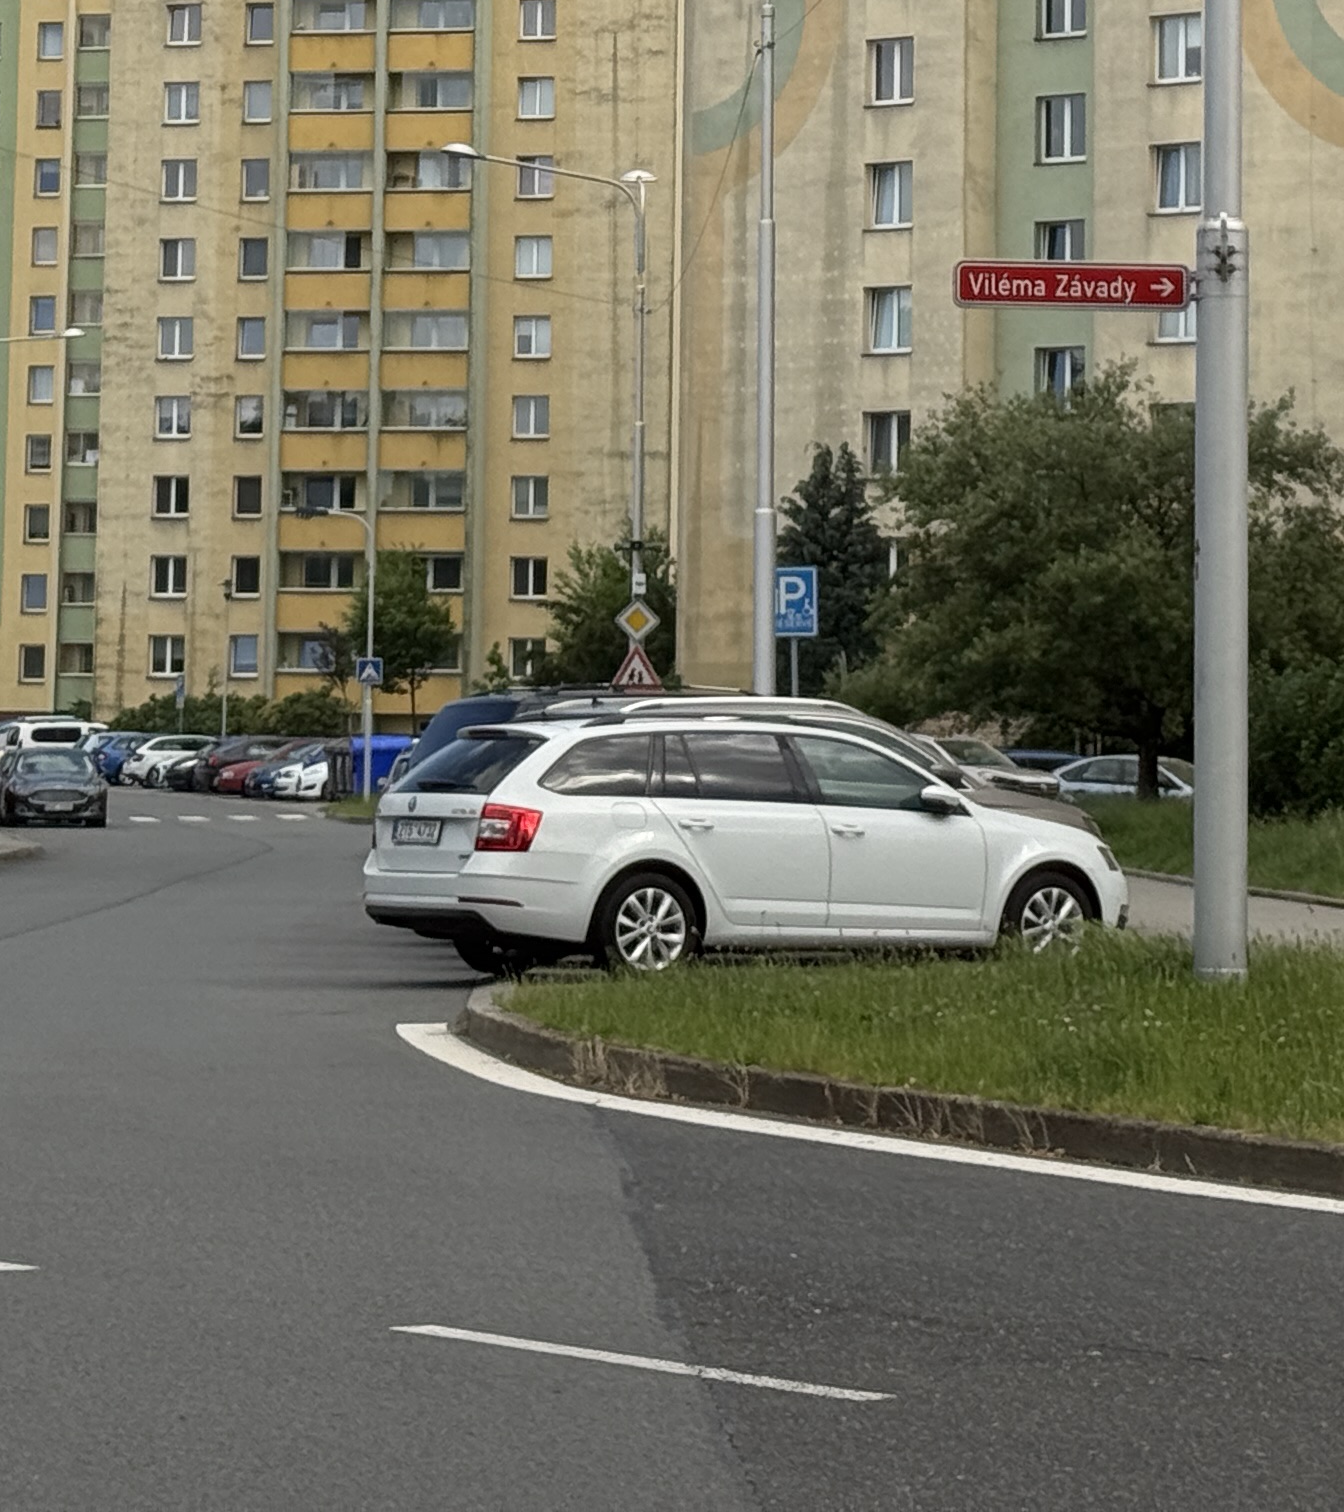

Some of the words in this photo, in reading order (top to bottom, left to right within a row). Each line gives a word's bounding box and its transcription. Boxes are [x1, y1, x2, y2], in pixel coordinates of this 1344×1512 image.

[969, 272, 1045, 296] Viléma
[1055, 274, 1136, 304] Závady
[779, 576, 806, 615] P
